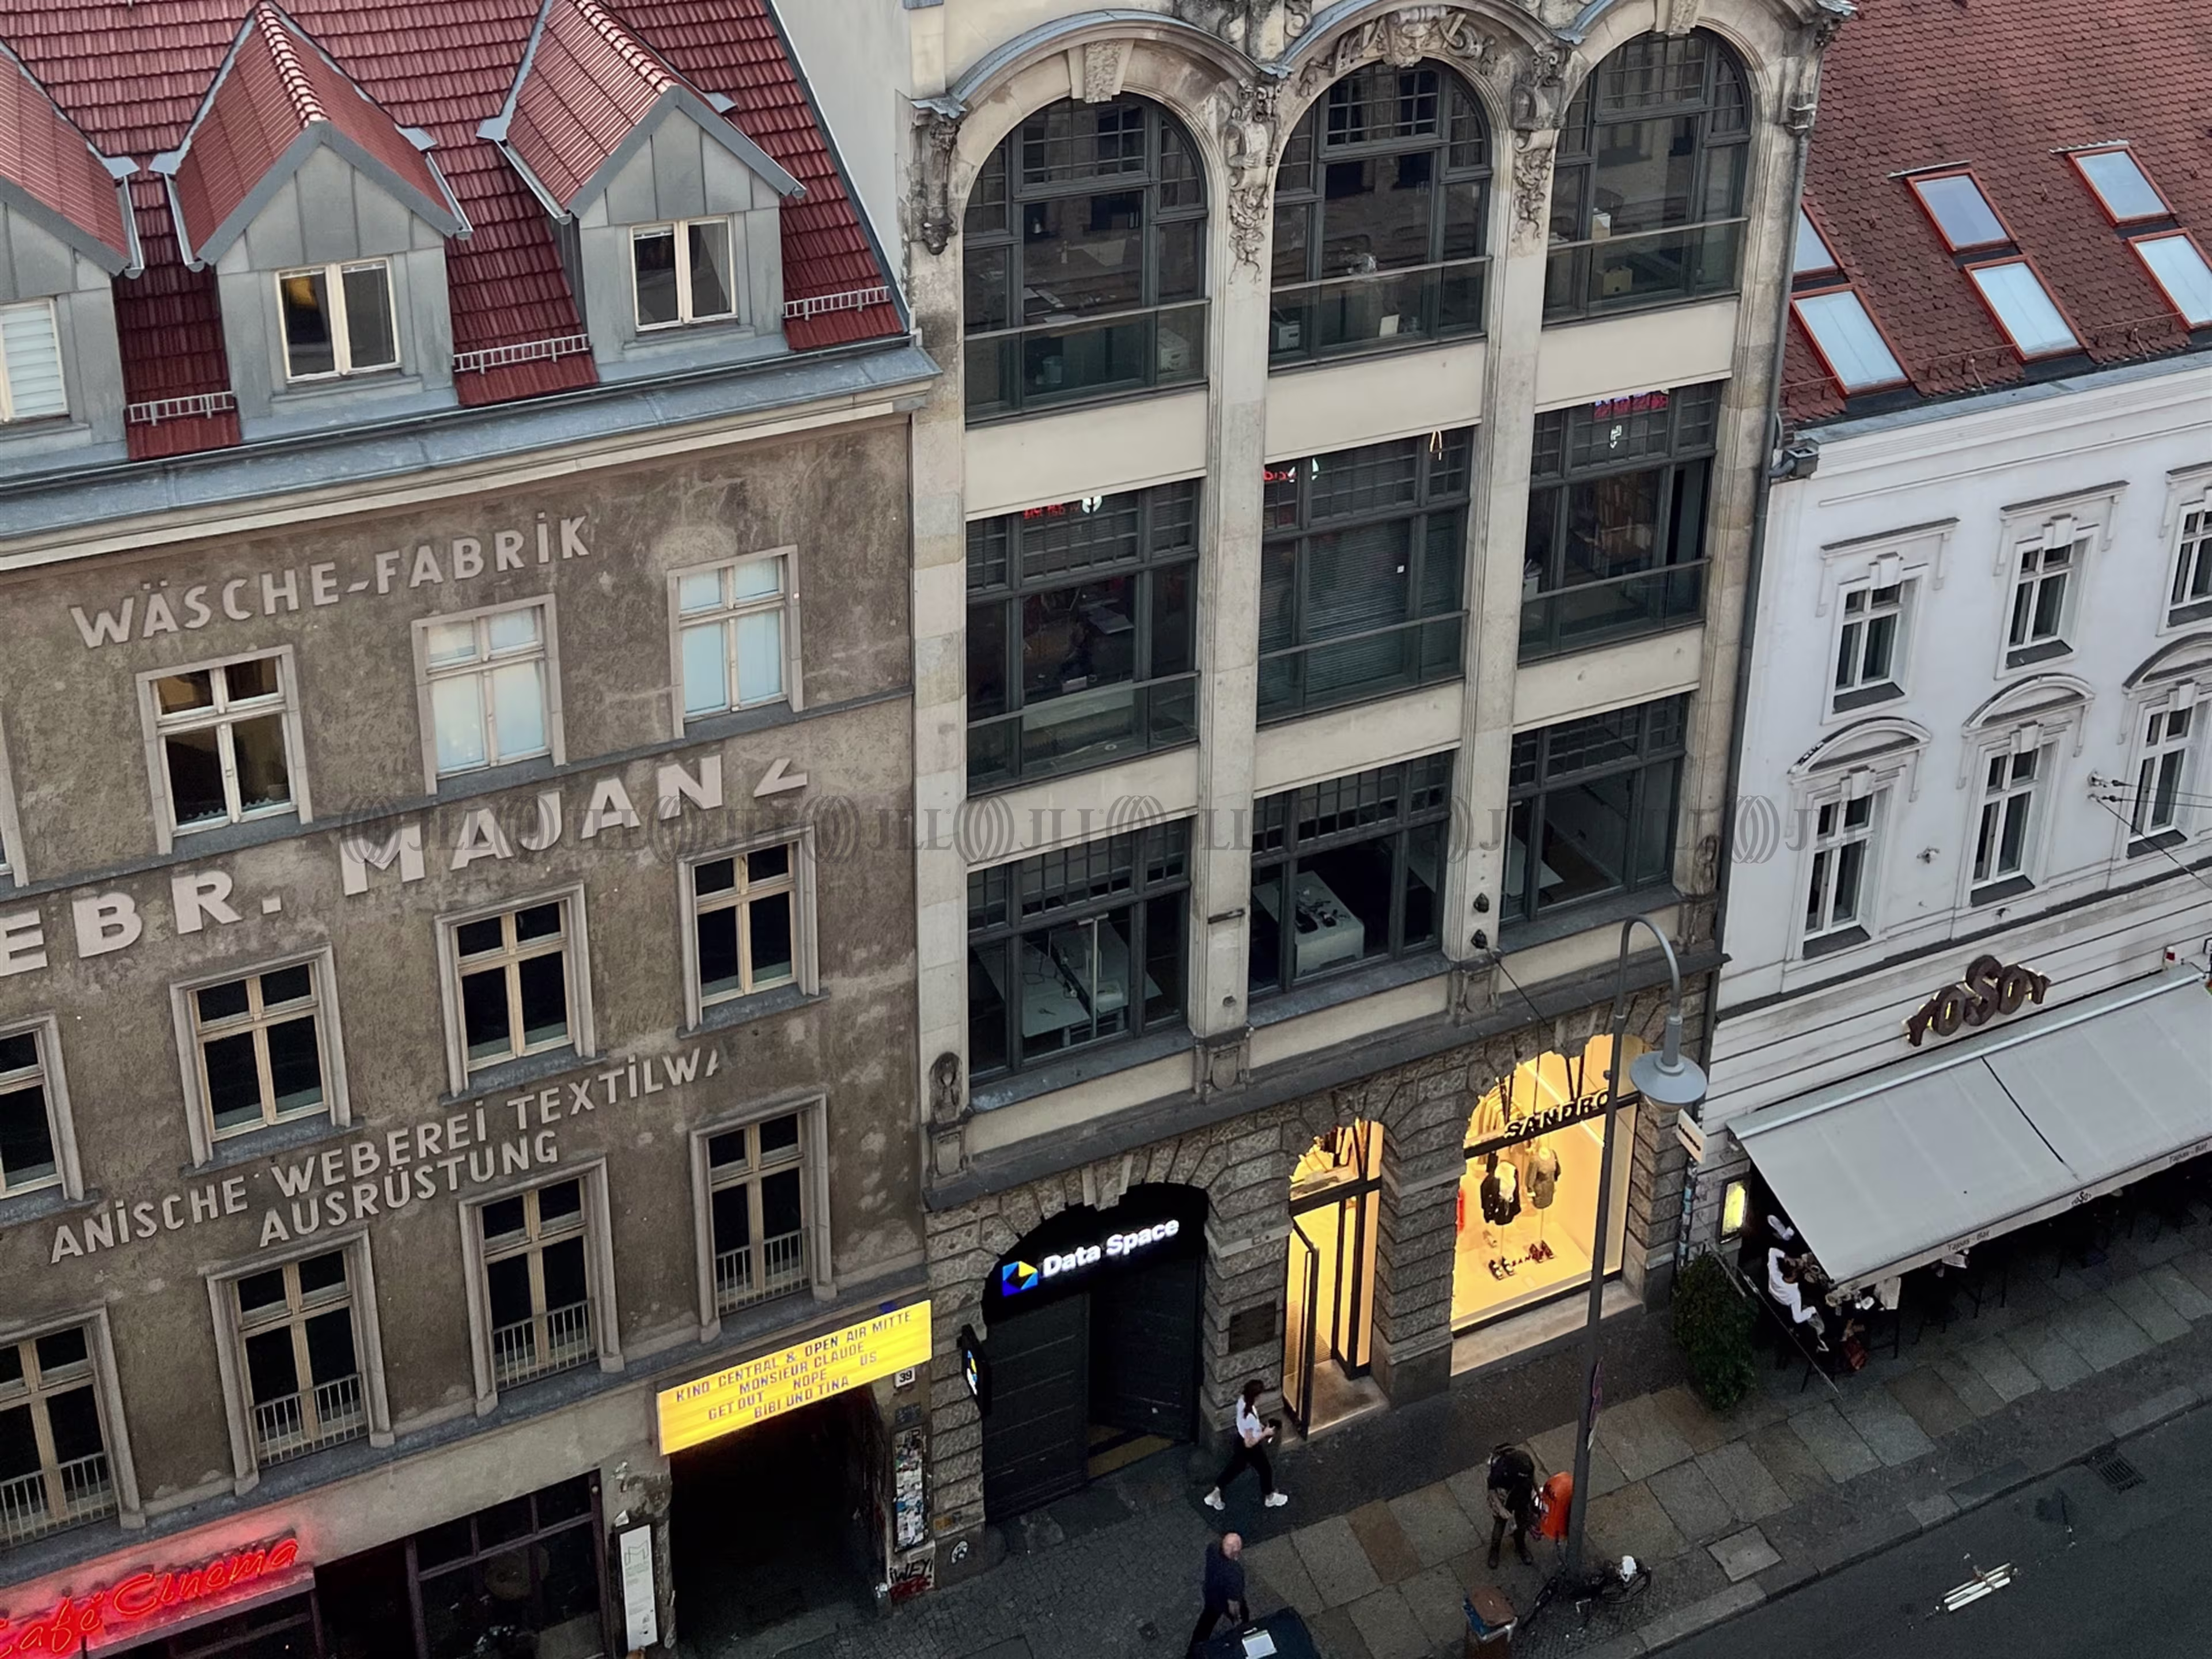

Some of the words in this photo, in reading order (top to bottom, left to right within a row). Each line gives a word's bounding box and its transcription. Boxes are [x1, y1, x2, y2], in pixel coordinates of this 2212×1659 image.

[259, 1130, 558, 1248] AUSRÜSTUNG
[1043, 1245, 1101, 1278] Data
[1107, 1219, 1179, 1255] Space
[677, 1381, 710, 1403] KINO
[719, 1357, 778, 1387] CENTRAL
[786, 1352, 796, 1363] &
[805, 1336, 838, 1357] OPEN
[847, 1327, 866, 1342] AIR
[872, 1310, 912, 1333] MITTE
[709, 1402, 734, 1421] GET
[738, 1390, 764, 1410] OUT
[793, 1369, 827, 1391] NOPE
[860, 1351, 877, 1366] US
[740, 1360, 808, 1395] MONSIEUR
[814, 1342, 865, 1369] CLAUDE
[899, 1370, 912, 1383] 39
[755, 1399, 781, 1419] BIBI
[786, 1390, 812, 1406] UND
[819, 1376, 850, 1395] TINA
[114, 1539, 299, 1615] Cinema
